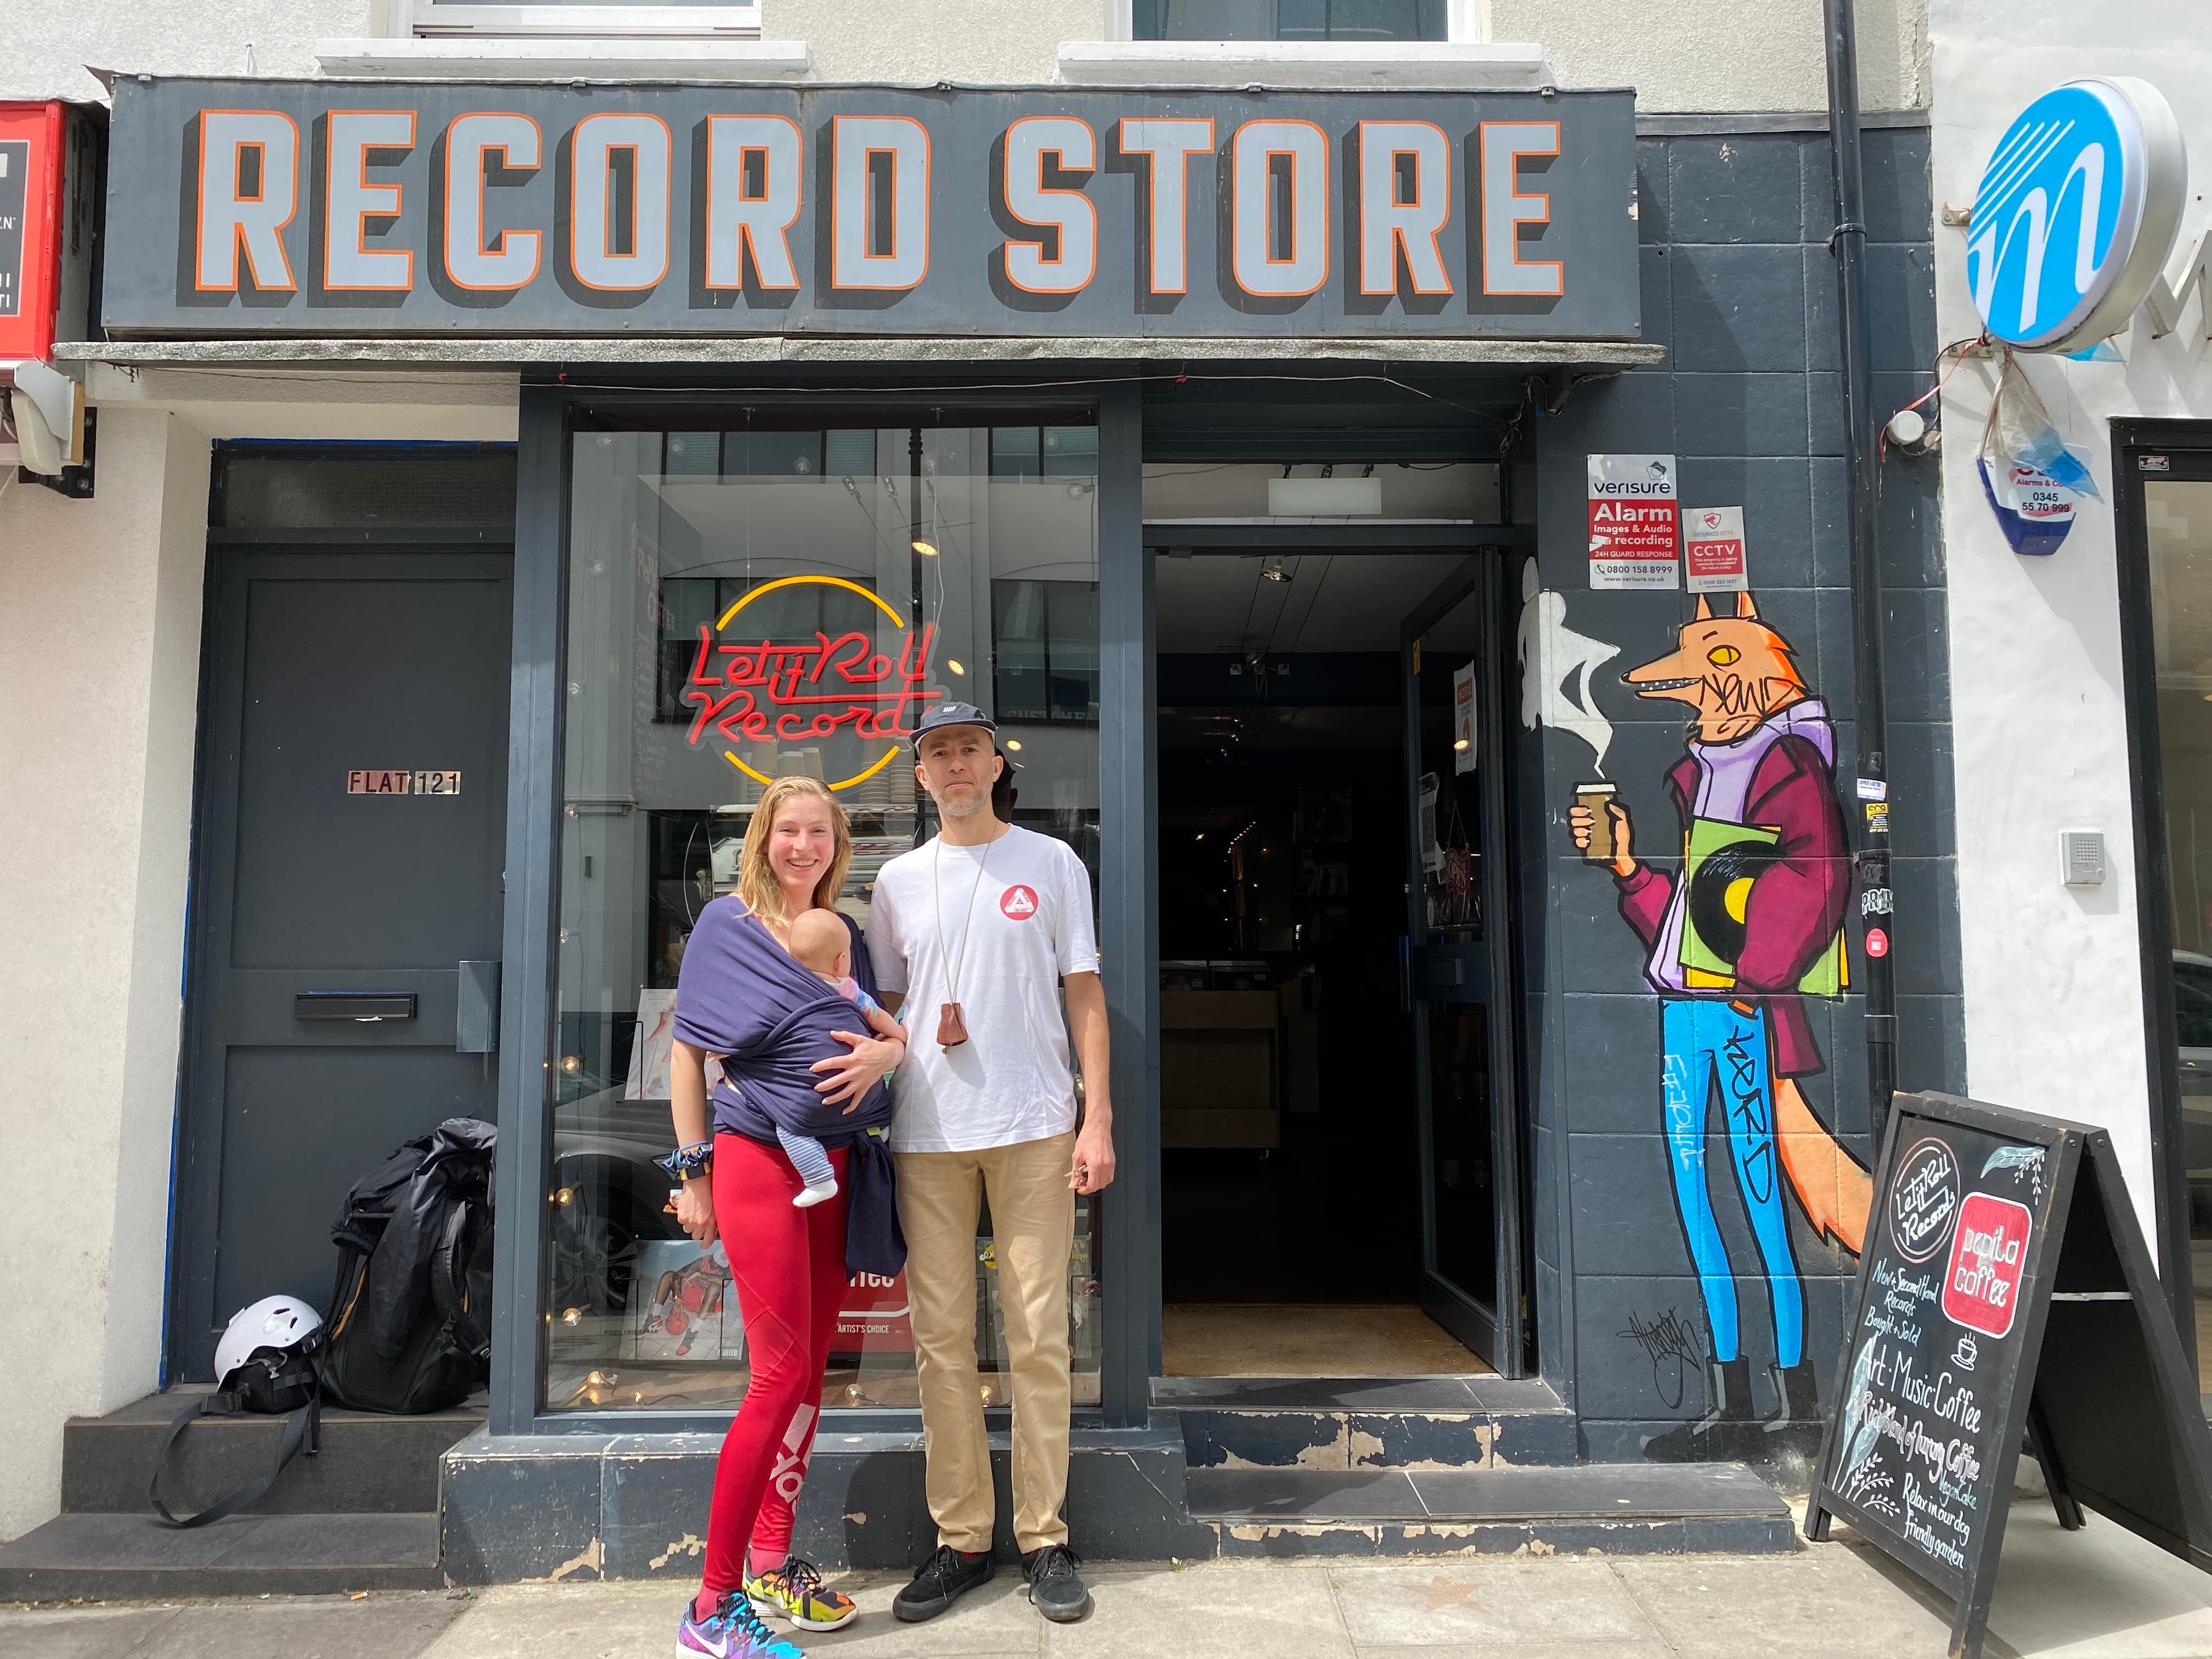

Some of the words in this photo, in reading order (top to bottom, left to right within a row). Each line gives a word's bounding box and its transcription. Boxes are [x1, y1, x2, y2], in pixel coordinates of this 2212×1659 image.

[195, 109, 930, 291] RECORD
[1004, 116, 1564, 296] STORE
[1594, 482, 1671, 494] verisure
[2033, 493, 2058, 501] 0345
[1594, 503, 1672, 522] Alarm
[2022, 503, 2034, 511] 55
[2037, 503, 2049, 511] 70
[2052, 504, 2069, 512] 999
[1594, 524, 1629, 534] Images
[1632, 524, 1640, 533] &
[1644, 524, 1672, 533] Audio
[1615, 534, 1673, 548] recording
[1694, 544, 1736, 557] CCTV
[693, 624, 769, 686] Let
[810, 623, 935, 684] Roll
[688, 680, 934, 745] Record
[349, 772, 408, 793] FLAT
[419, 772, 457, 793] 121
[1448, 860, 1466, 889] OPEN
[1895, 1175, 1919, 1220] Let
[1922, 1152, 1951, 1195] Roll
[1901, 1186, 1956, 1246] Records
[1959, 1226, 2020, 1269] pepita
[1872, 1257, 1894, 1286] New
[1893, 1267, 1922, 1298] Second
[1919, 1274, 1940, 1305] Hand
[1954, 1261, 2011, 1308] coffee
[1884, 1290, 1916, 1317] Records
[837, 1325, 866, 1334] ARTIST'S
[867, 1325, 890, 1334] CHOICE
[1864, 1305, 1895, 1336] Bought
[1898, 1320, 1922, 1347] Sold
[1854, 1337, 1888, 1387] Art
[1891, 1350, 1932, 1408] Music
[1934, 1372, 1982, 1434] Coffee
[1946, 1438, 1981, 1482] Coffee
[1902, 1472, 1928, 1513] Relax
[1938, 1509, 1956, 1526] our
[1954, 1510, 1971, 1547] dog
[1957, 1481, 1977, 1510] Cake
[1933, 1539, 1964, 1570] garden
